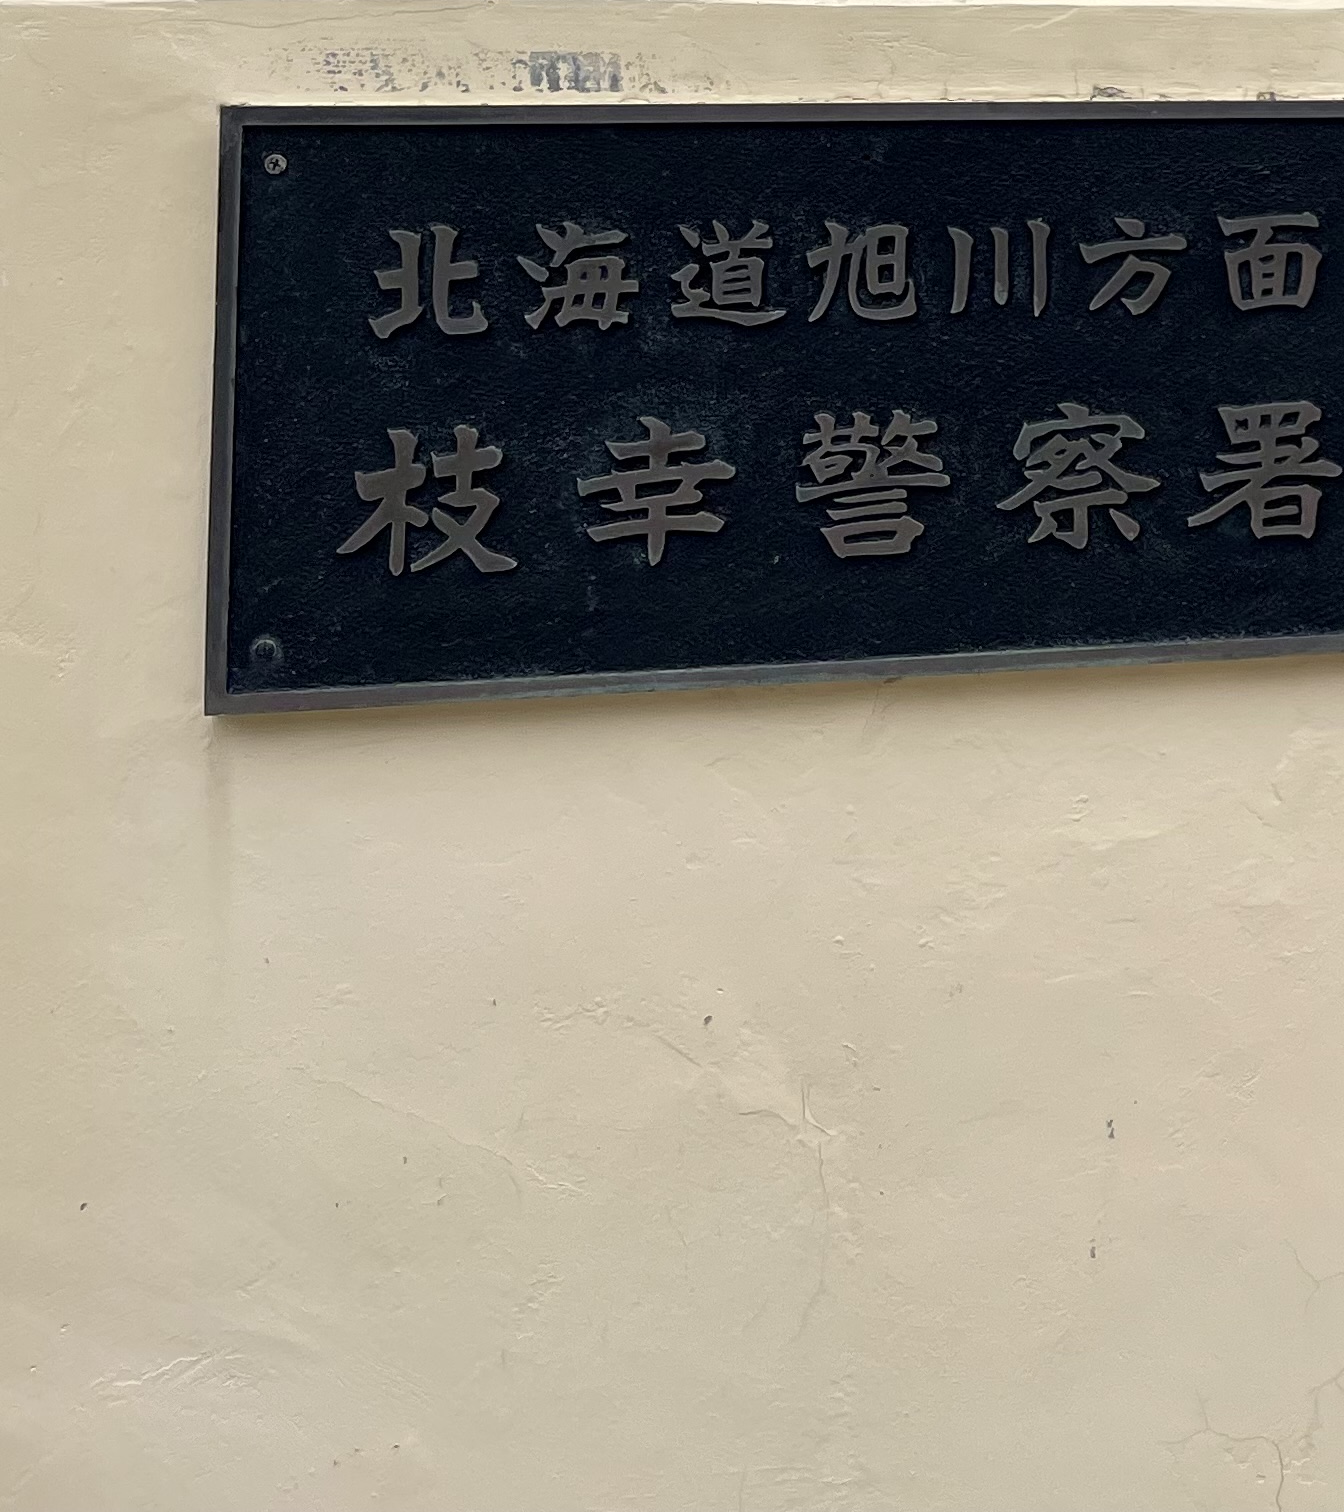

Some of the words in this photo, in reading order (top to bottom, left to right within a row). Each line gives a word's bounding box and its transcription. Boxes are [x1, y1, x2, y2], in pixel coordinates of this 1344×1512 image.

[371, 208, 1327, 340] 北海道旭川方面
[337, 399, 1342, 576] 枝幸警察署
